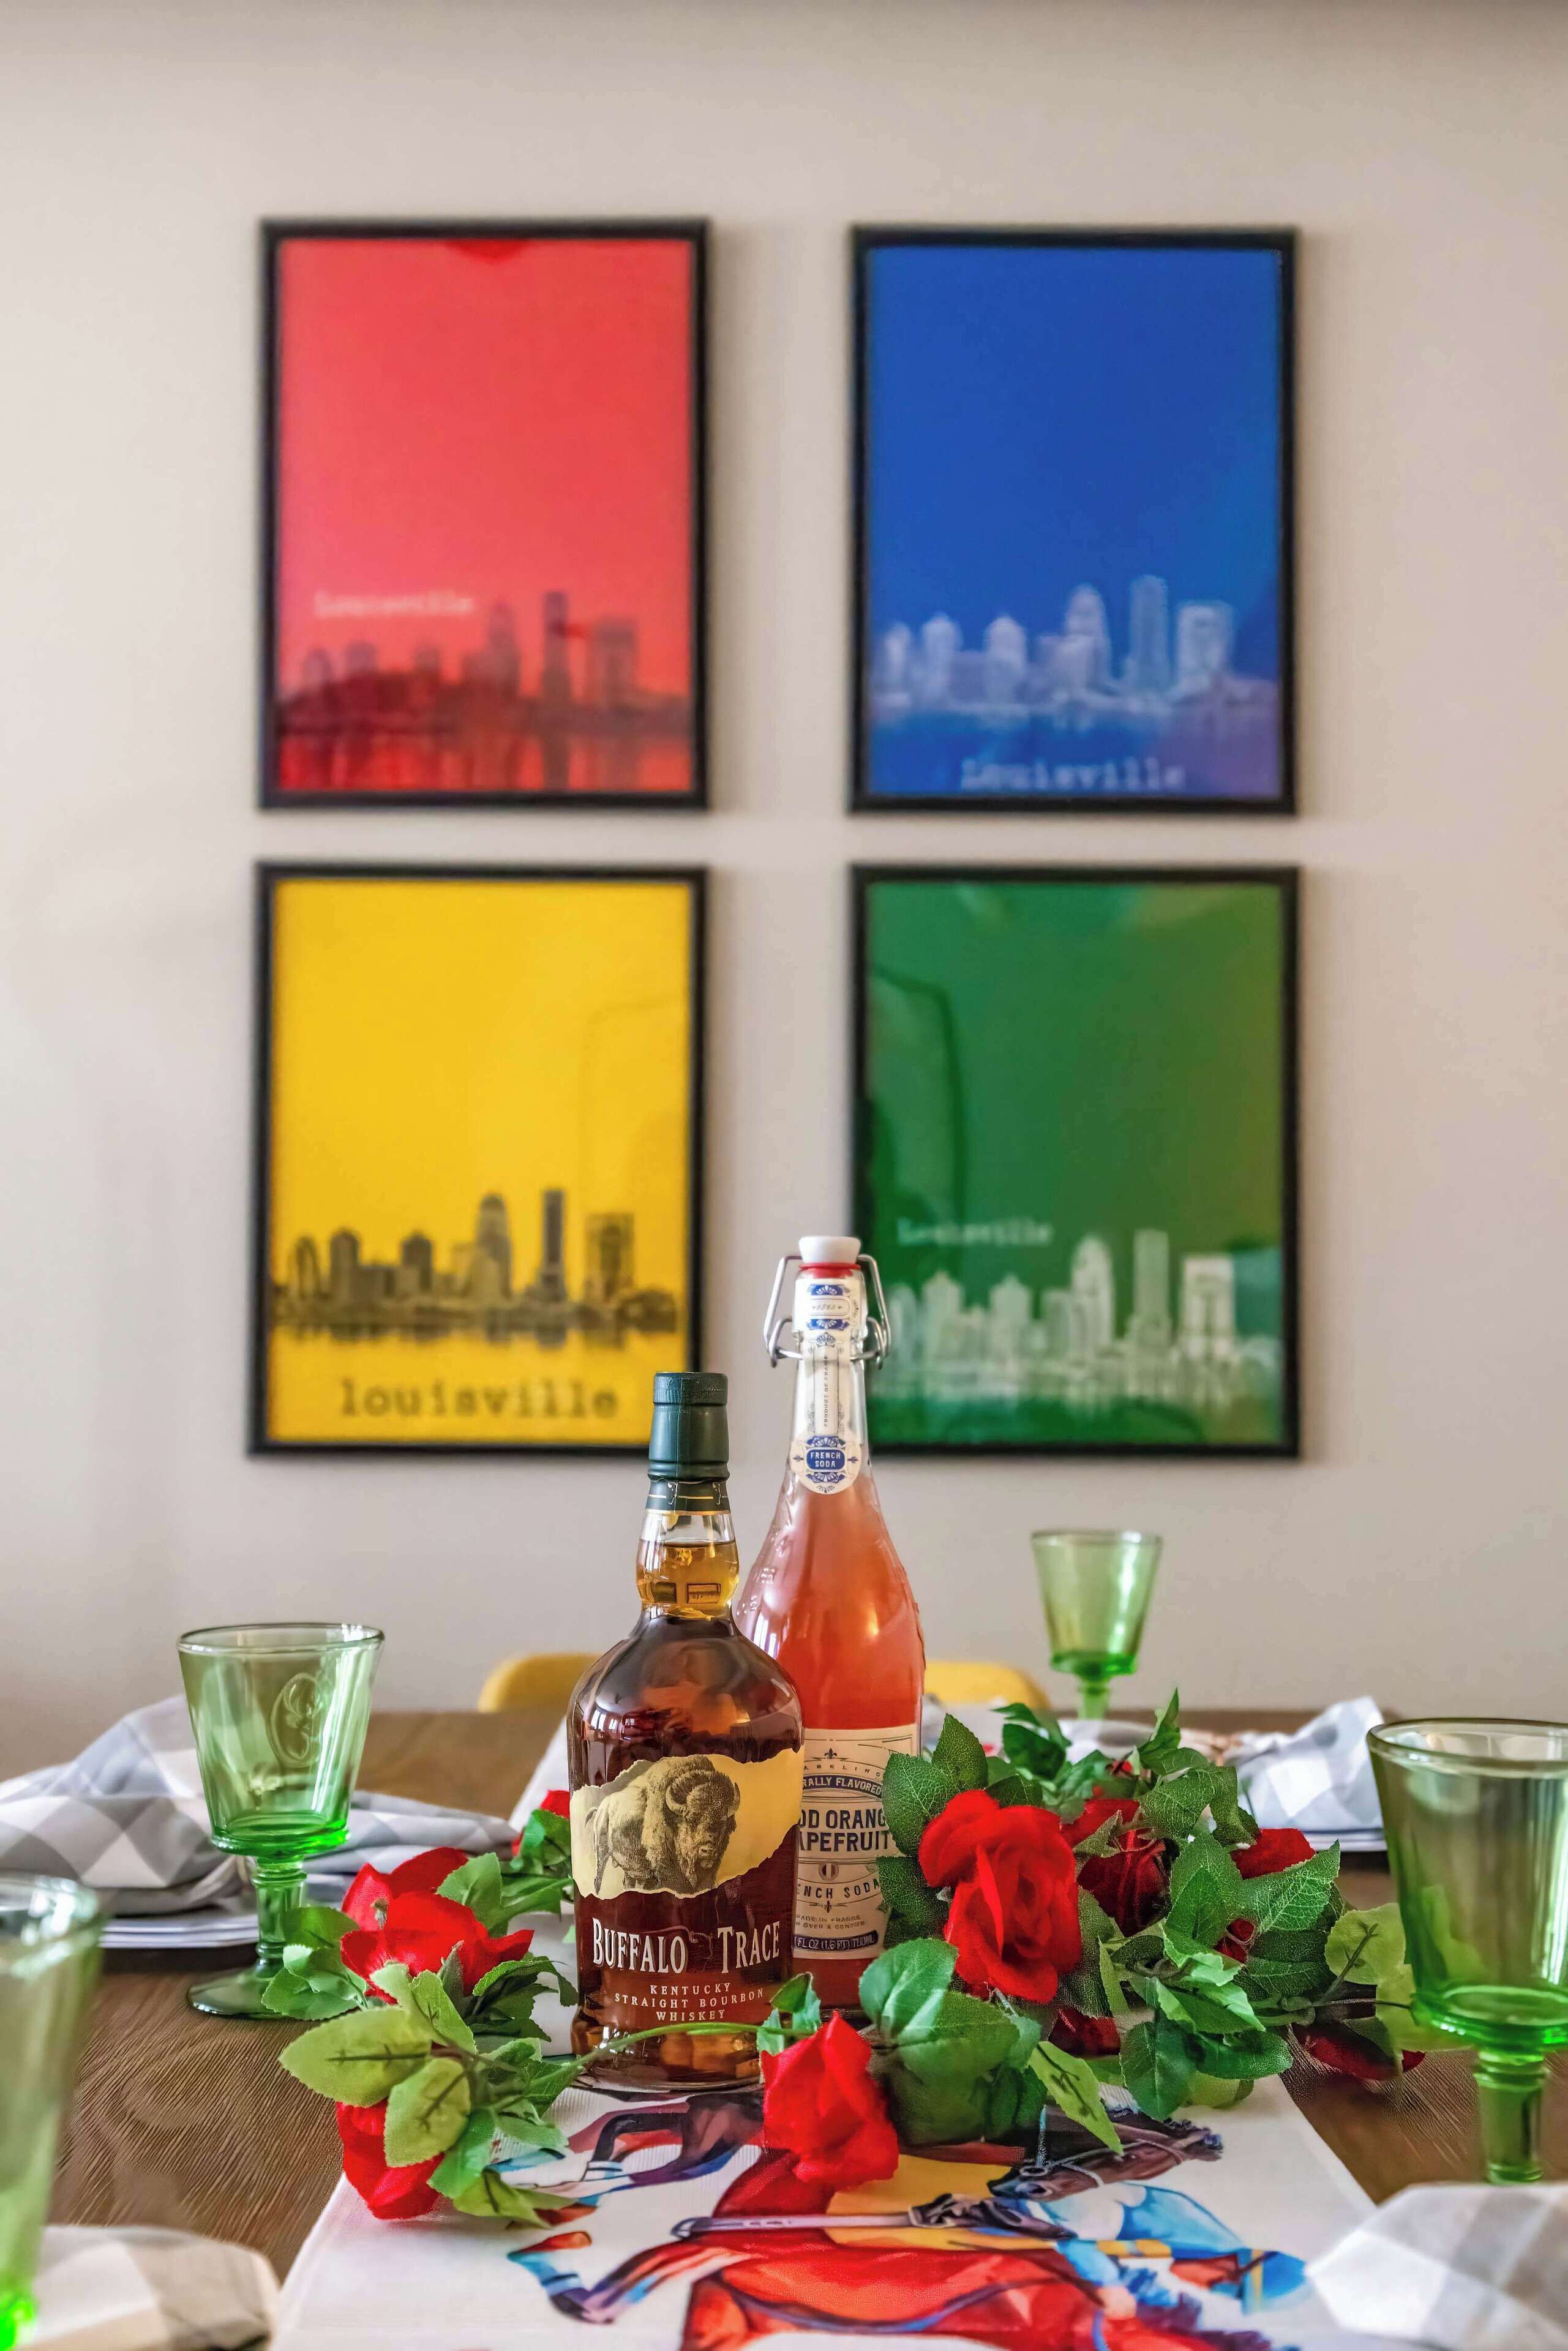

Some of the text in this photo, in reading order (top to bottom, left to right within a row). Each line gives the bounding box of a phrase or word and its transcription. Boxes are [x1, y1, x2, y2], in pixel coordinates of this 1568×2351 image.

[340, 1378, 618, 1418] louisville
[836, 1778, 882, 1796] FLAVORED
[844, 1878, 880, 1898] SODA
[592, 1917, 781, 1974] BUFFALO TRACE
[615, 1988, 763, 2008] STRAIGHT BOURBON
[650, 1982, 730, 1995] KENTUCKY
[656, 2009, 726, 2021] WHISKEY
